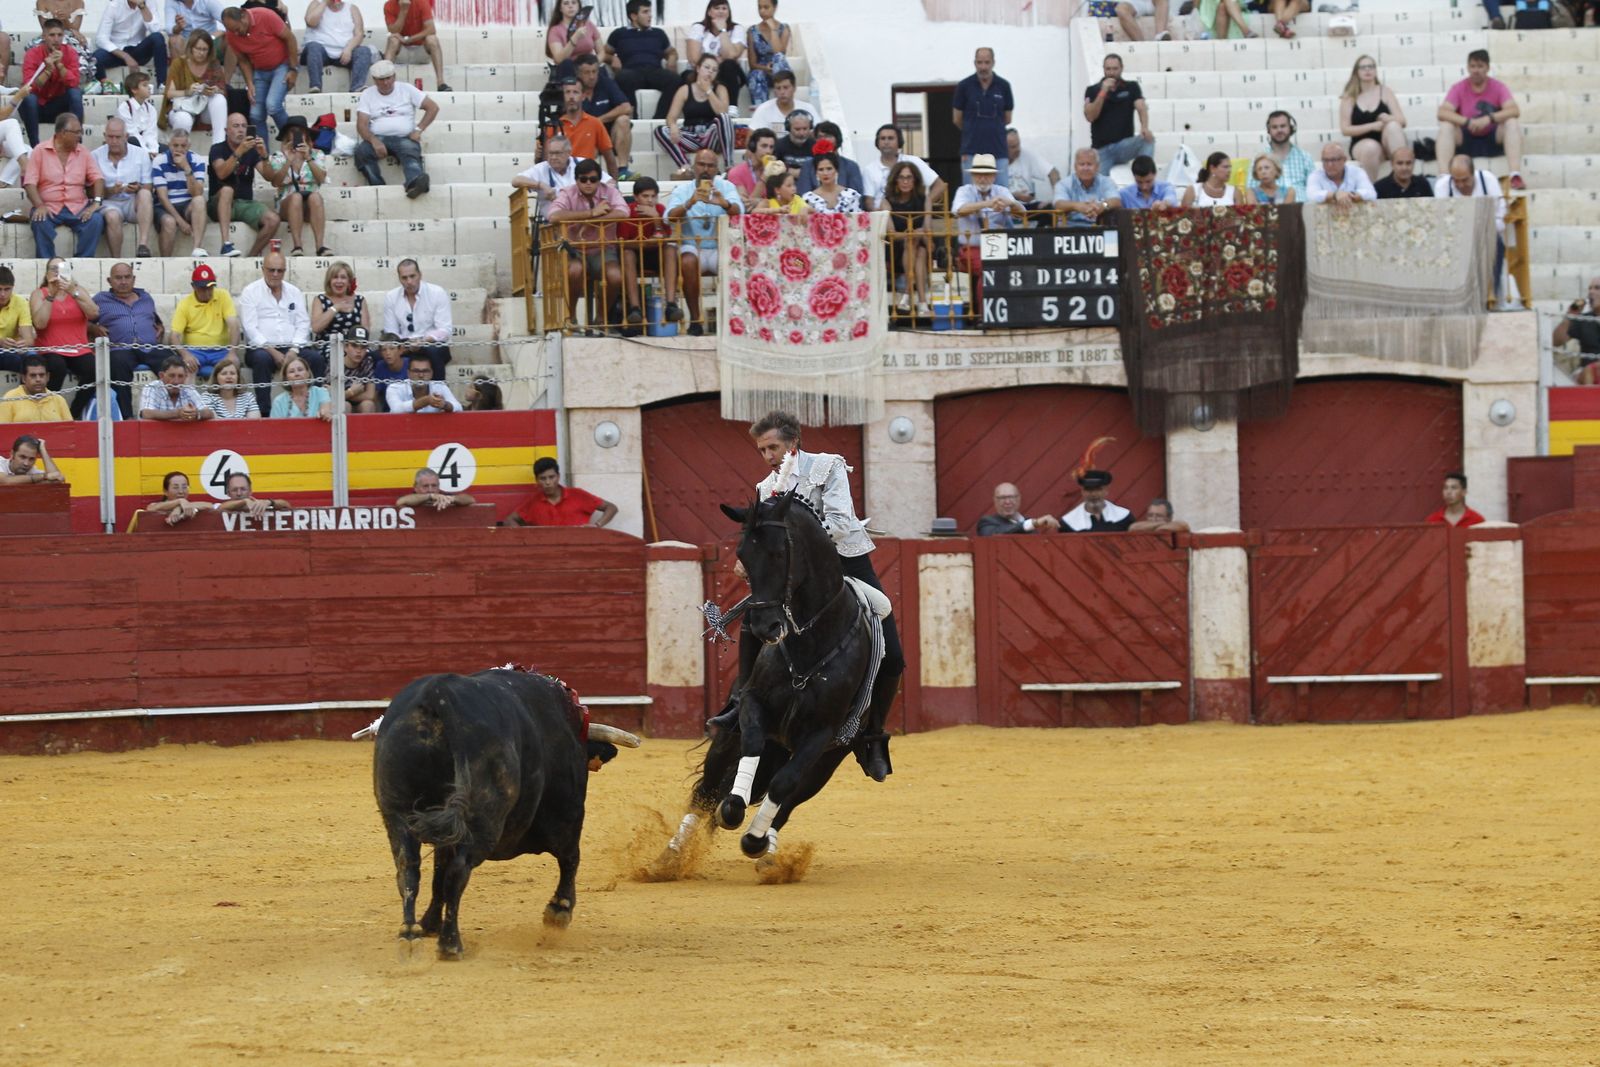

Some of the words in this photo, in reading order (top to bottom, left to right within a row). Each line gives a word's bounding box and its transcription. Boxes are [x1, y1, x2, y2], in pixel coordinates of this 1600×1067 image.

[1007, 237, 1033, 256] SAN
[1054, 235, 1104, 255] PELAYO
[983, 270, 996, 287] N
[1009, 270, 1023, 287] 8
[983, 297, 1008, 323] KG
[1041, 295, 1115, 321] 520
[904, 353, 920, 367] EL
[926, 353, 938, 366] 19
[945, 353, 962, 366] DE
[970, 350, 1050, 365] SEPTIEMBRE
[1057, 350, 1074, 363] DE
[1080, 349, 1108, 362] 1887
[210, 455, 231, 495] 4
[438, 447, 461, 488] 4
[222, 507, 416, 532] VETERINARIOS
